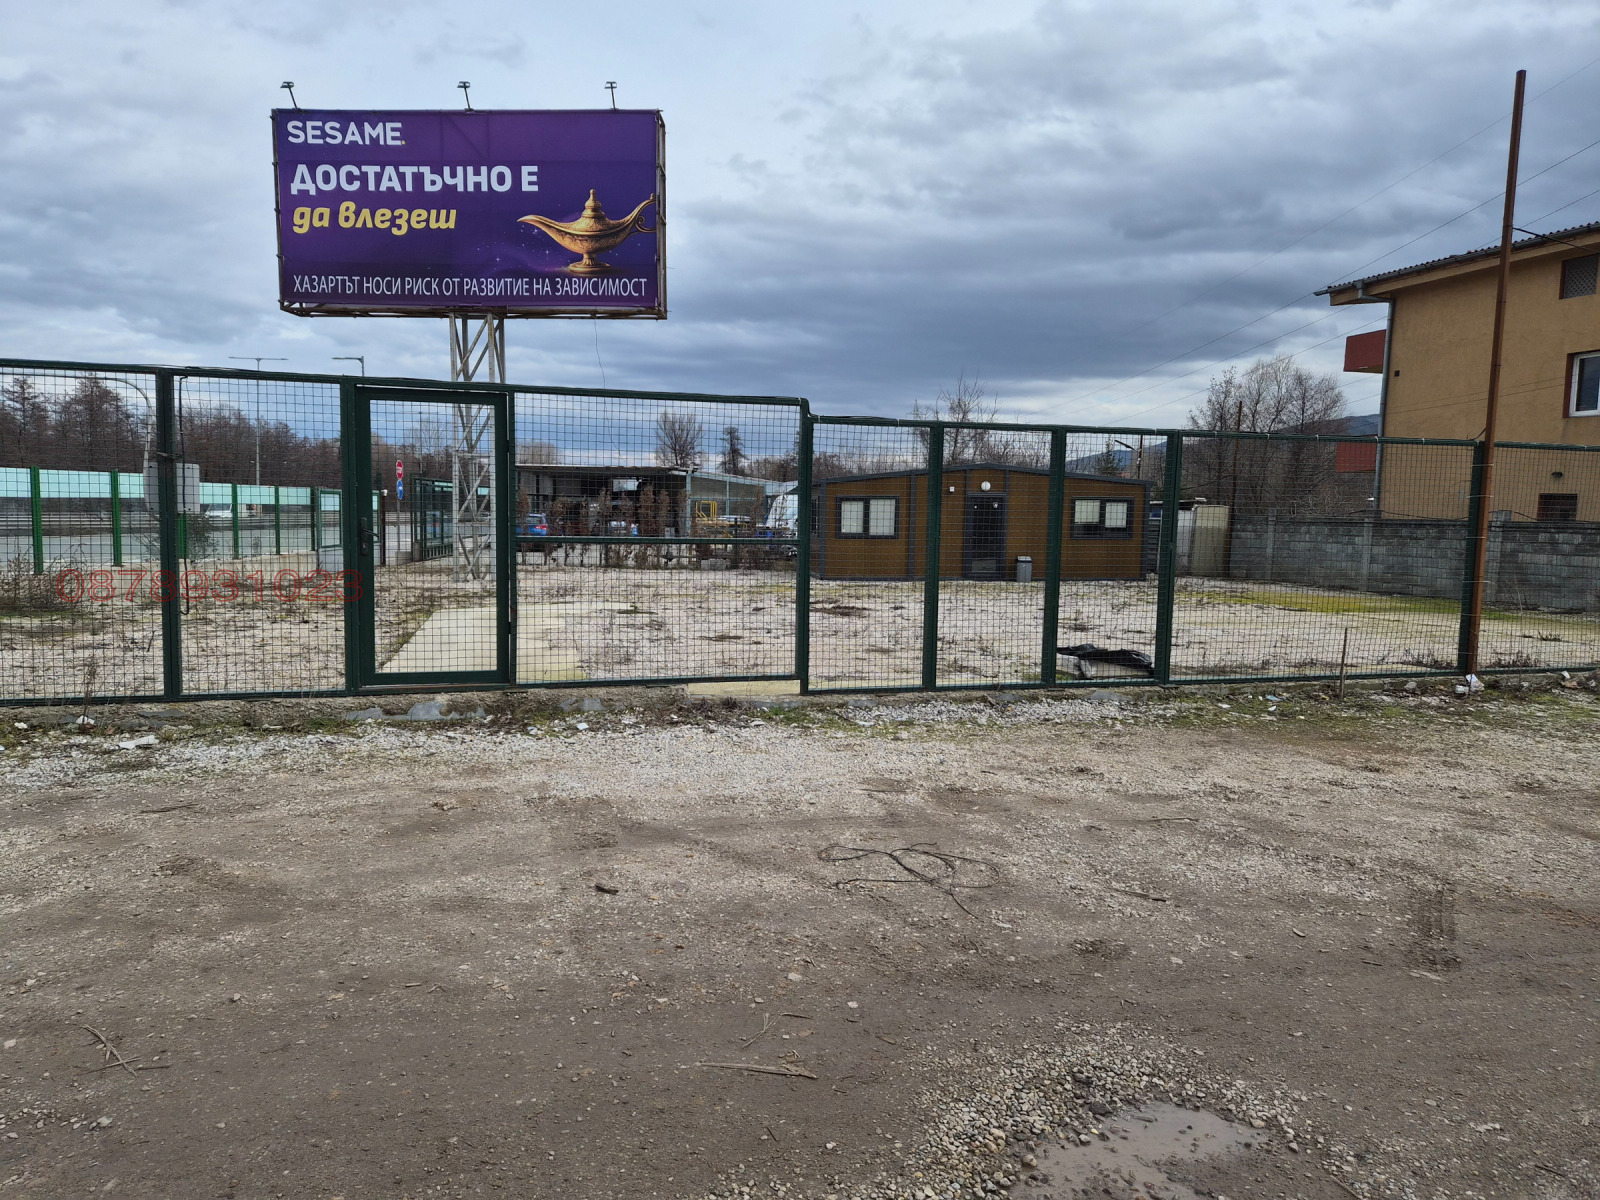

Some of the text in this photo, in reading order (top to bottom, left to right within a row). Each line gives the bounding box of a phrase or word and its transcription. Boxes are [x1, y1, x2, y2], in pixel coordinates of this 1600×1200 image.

[290, 164, 539, 195] ДОСТАТЪЧНО Е
[293, 200, 457, 236] да влезеш
[293, 274, 648, 297] ХАЗАРТЪТ НОСИ РИСК ОТ РАЗВИТИЕ НА ЗАВИСИМОСТ
